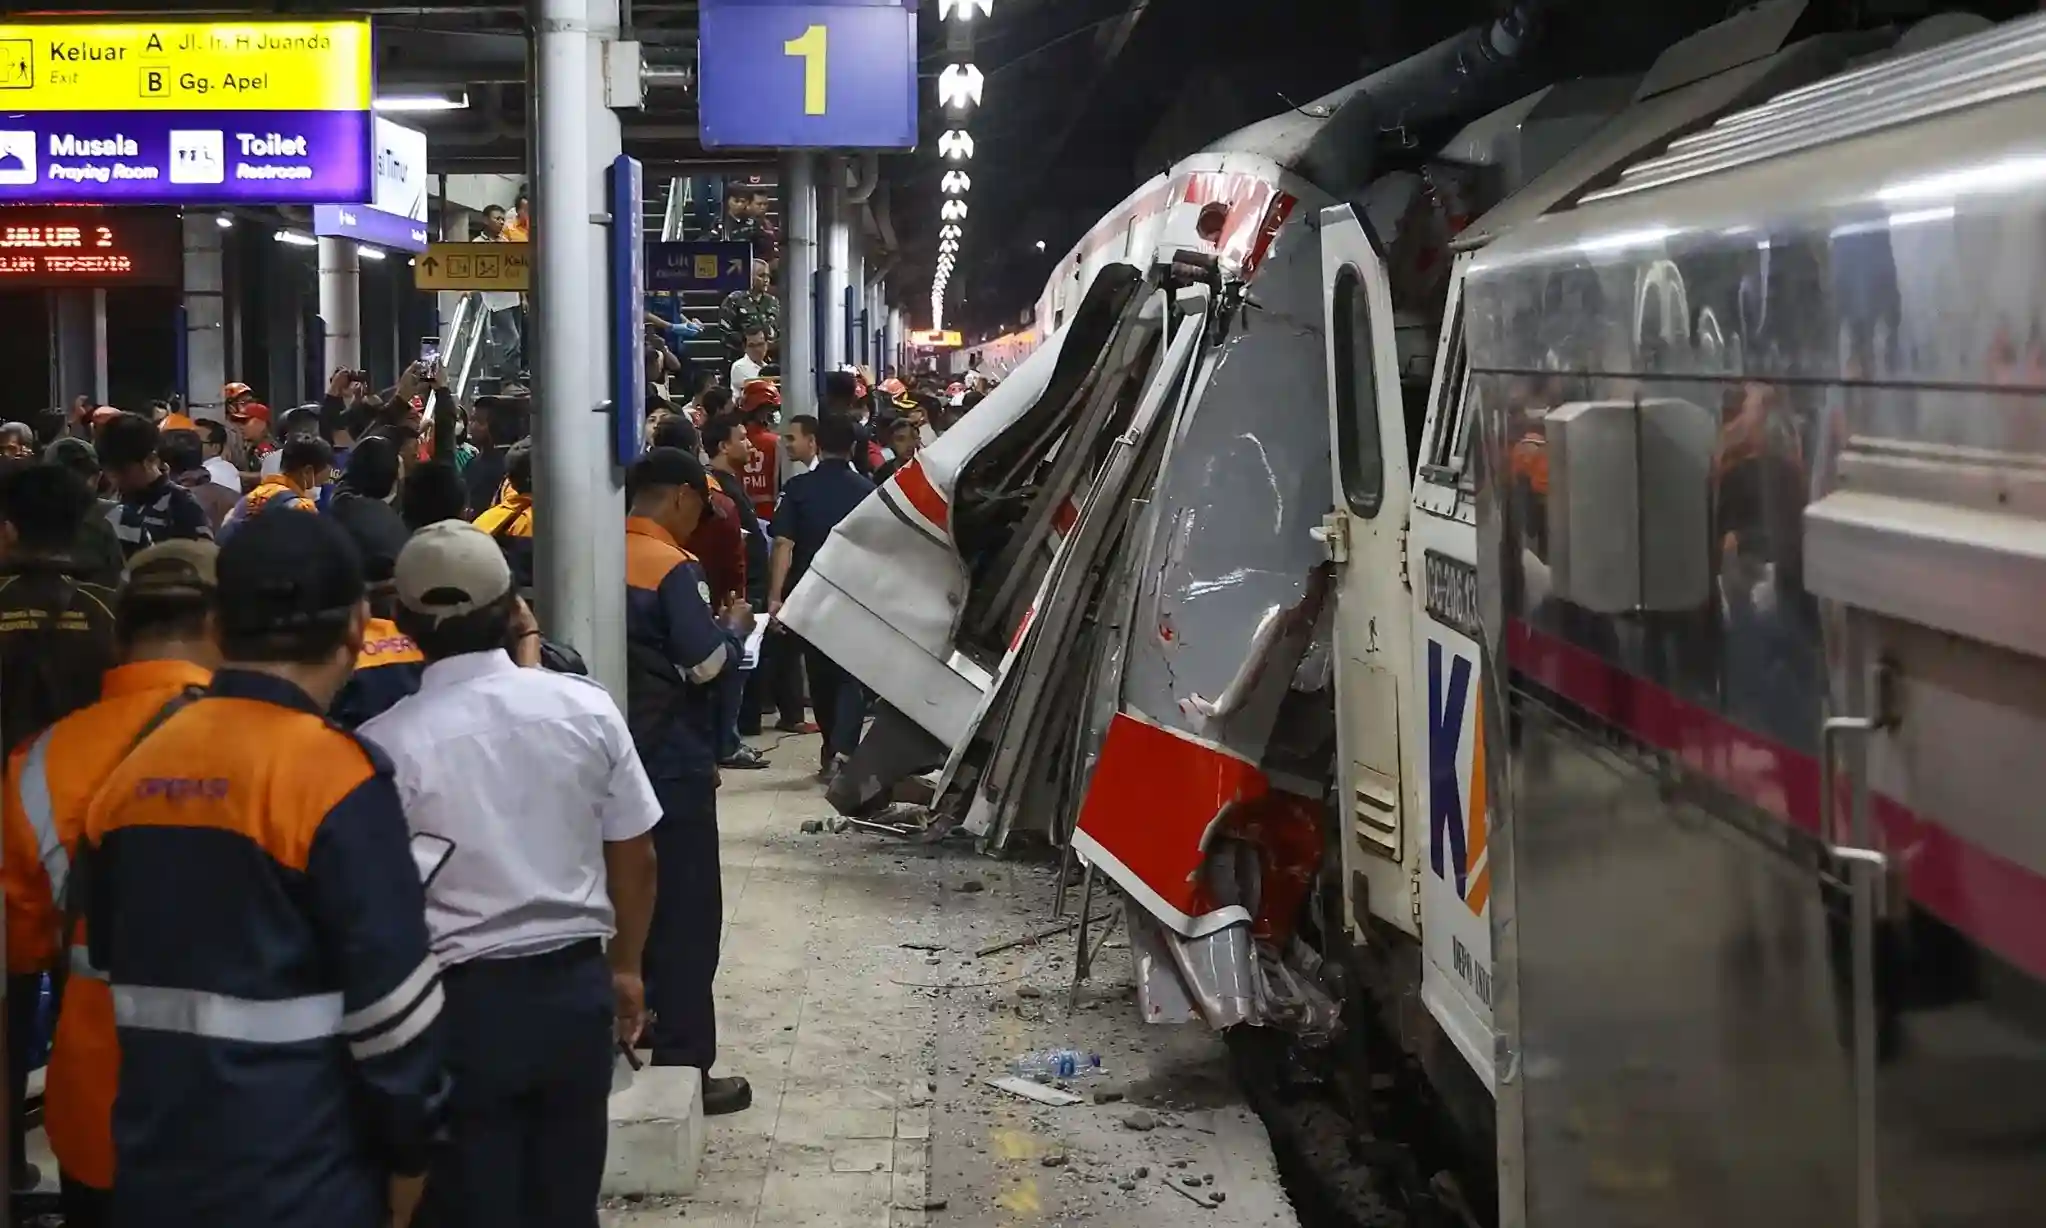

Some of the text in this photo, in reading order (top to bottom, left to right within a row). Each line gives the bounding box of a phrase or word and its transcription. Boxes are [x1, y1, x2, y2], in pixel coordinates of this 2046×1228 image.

[50, 42, 128, 62] Keluar
[146, 33, 163, 52] A
[179, 34, 202, 50] Jl.
[257, 34, 331, 50] Juanda
[50, 70, 78, 84] Exit
[784, 25, 827, 115] 1
[148, 72, 268, 94] B Gg. Apel
[49, 133, 139, 157] Musala
[235, 132, 308, 157] Toilet
[48, 162, 159, 183] Praying Room
[235, 162, 313, 179] Restroom
[0, 226, 112, 247] JALUR 2
[743, 475, 766, 488] PMI
